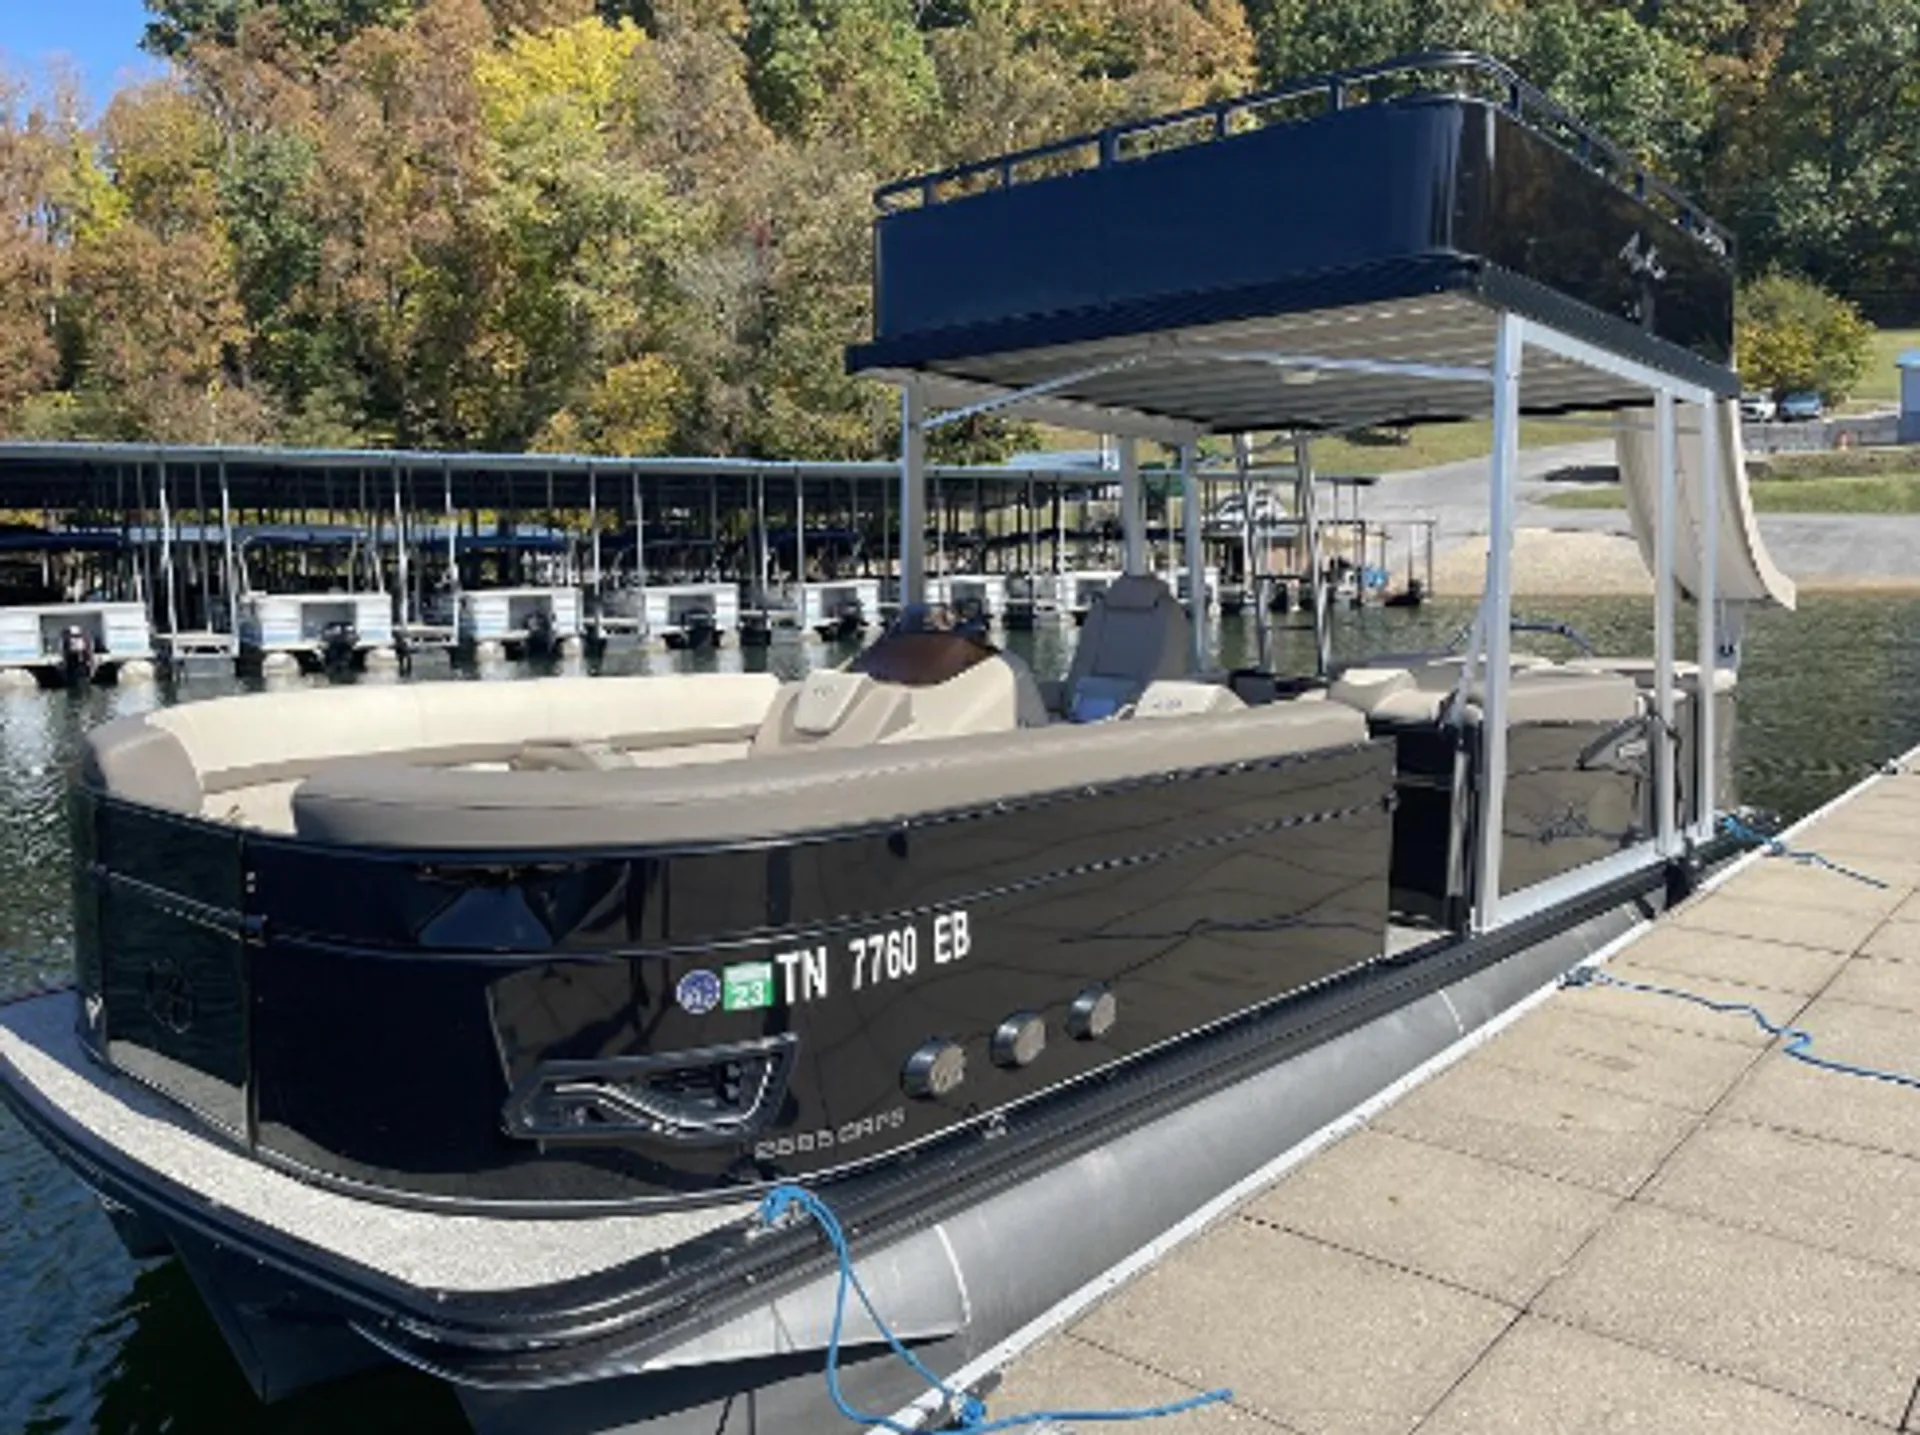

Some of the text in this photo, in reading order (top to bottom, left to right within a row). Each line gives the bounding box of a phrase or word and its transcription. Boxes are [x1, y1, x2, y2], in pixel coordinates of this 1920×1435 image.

[776, 946, 828, 1005] TN
[848, 925, 918, 991] 7760
[934, 910, 971, 964] EB
[732, 980, 765, 1010] 23
